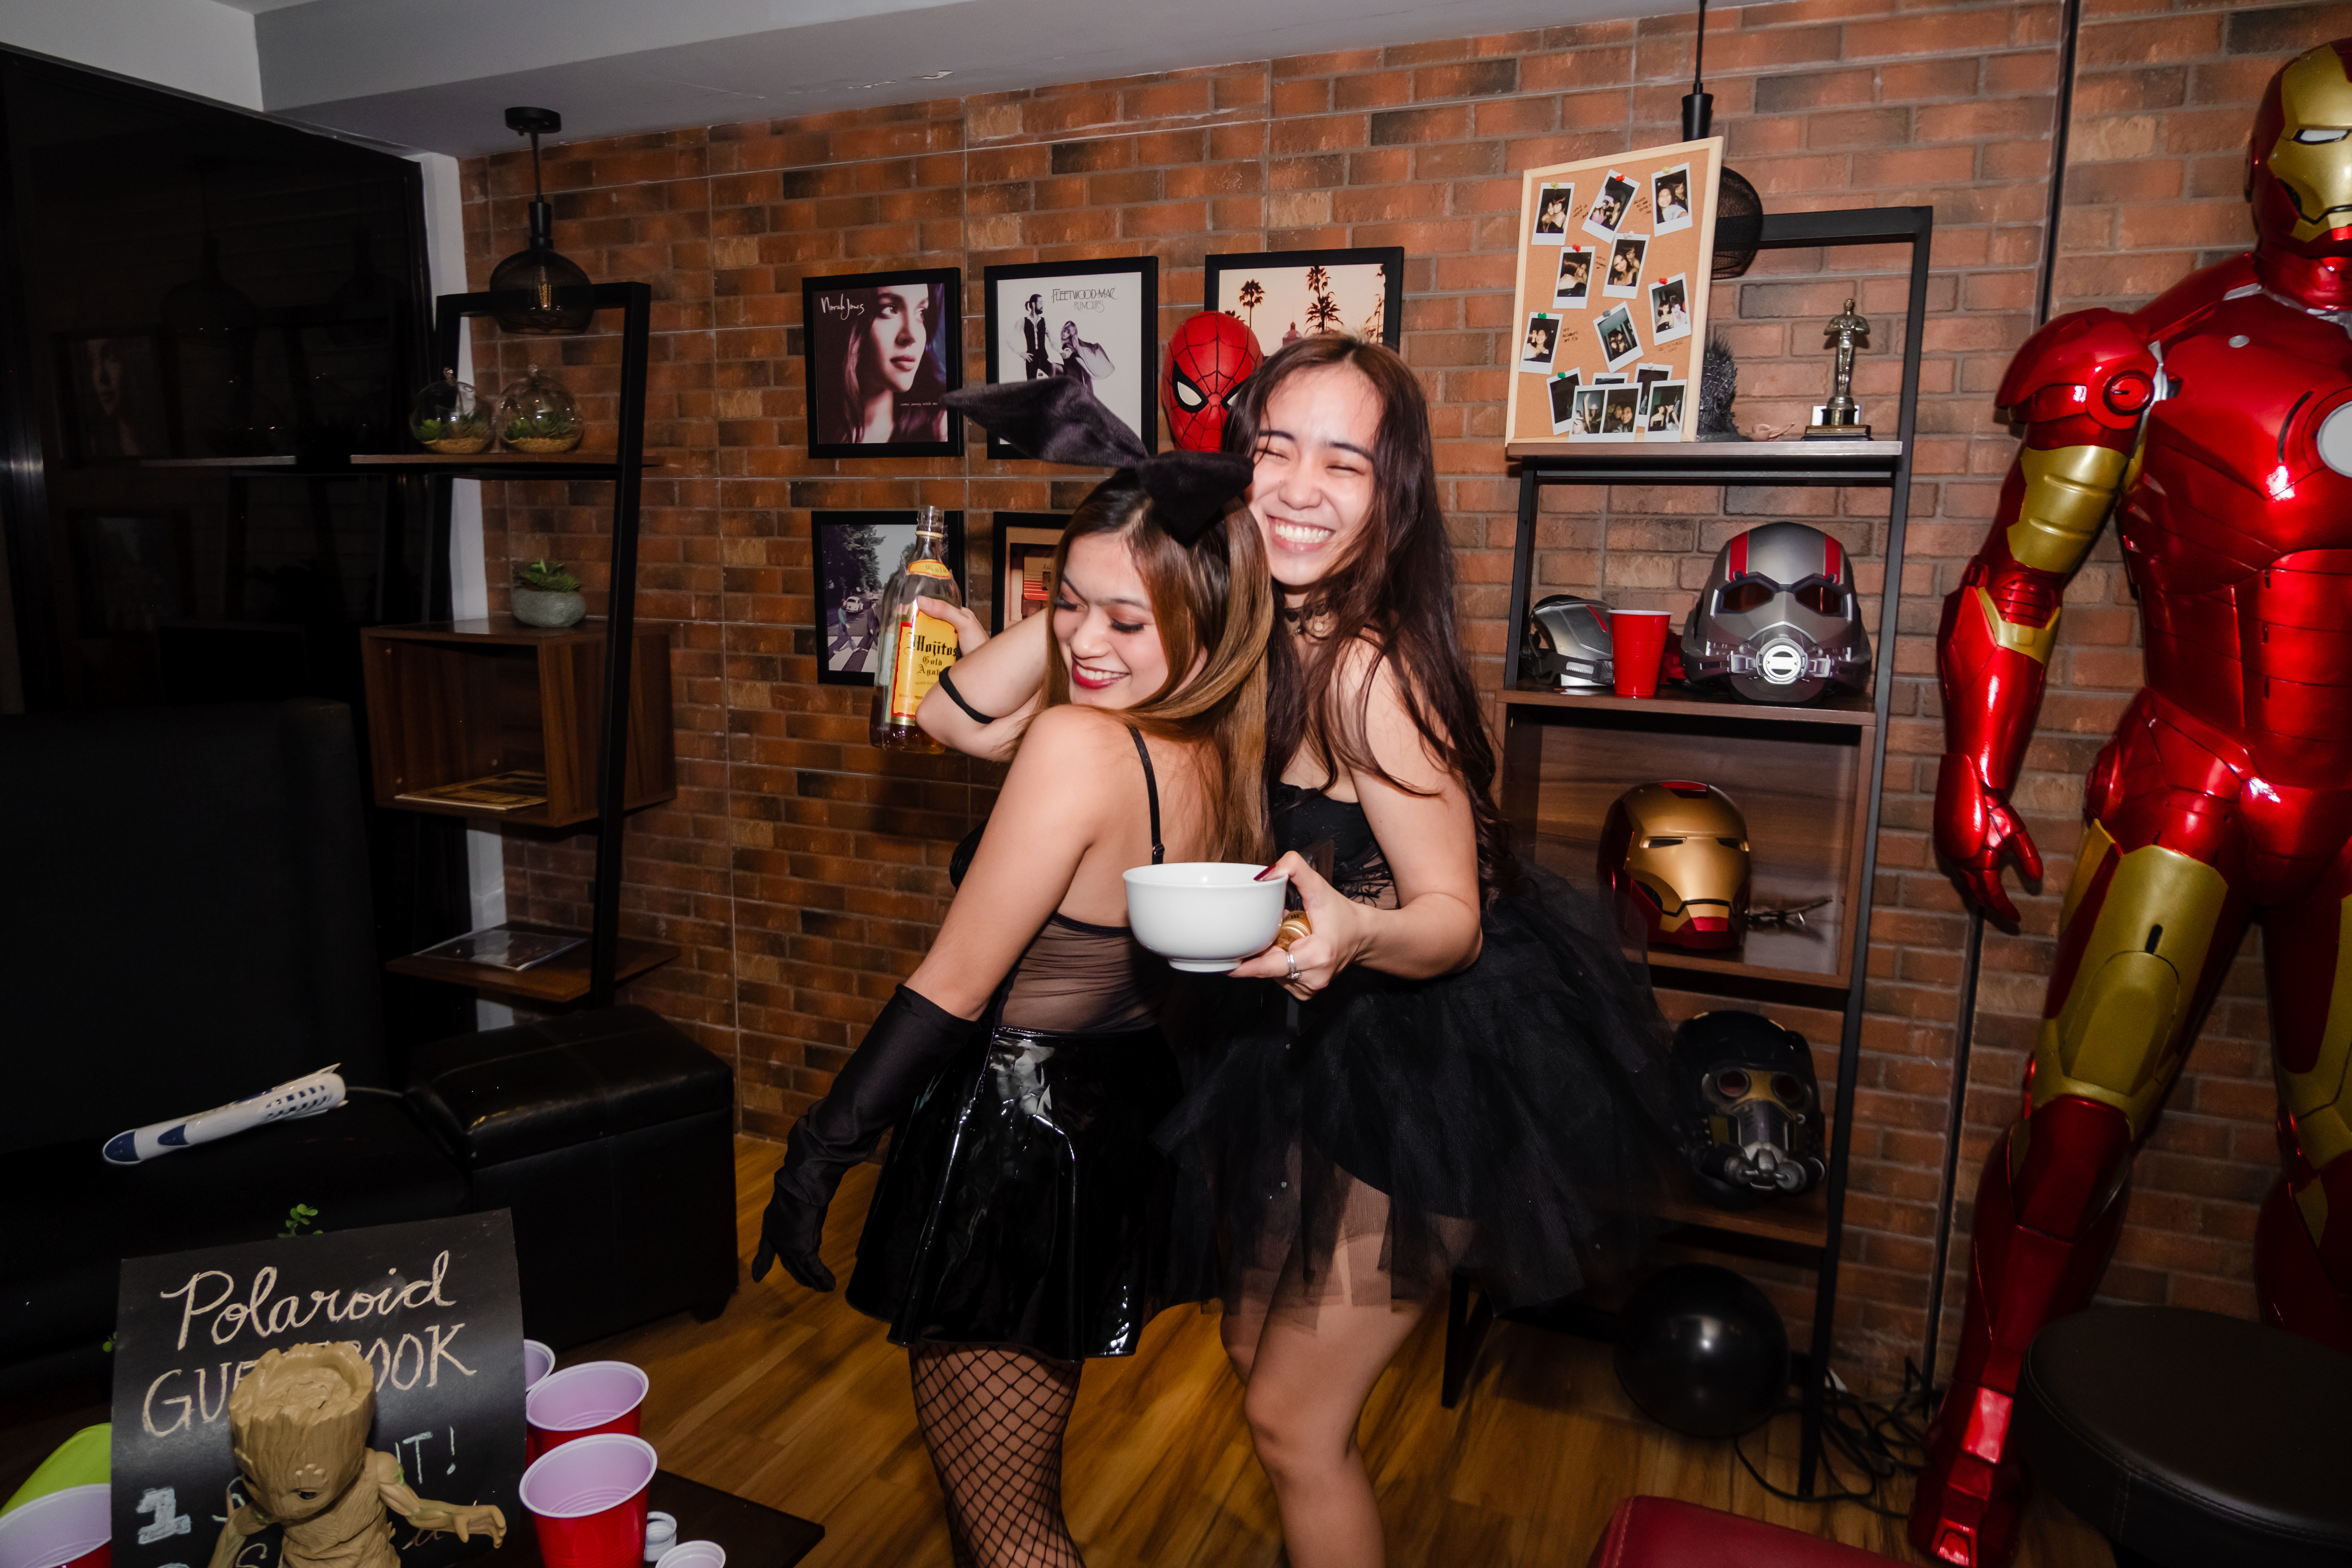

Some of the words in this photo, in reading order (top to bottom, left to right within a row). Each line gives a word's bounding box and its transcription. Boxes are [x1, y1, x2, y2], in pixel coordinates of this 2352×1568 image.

[1051, 289, 1096, 303] FLEETWOOD
[1097, 286, 1120, 299] MAC
[1074, 300, 1105, 313] RUMOURS
[904, 632, 957, 657] Mojitos
[922, 655, 943, 666] Gold
[160, 1250, 457, 1351] Polaroid
